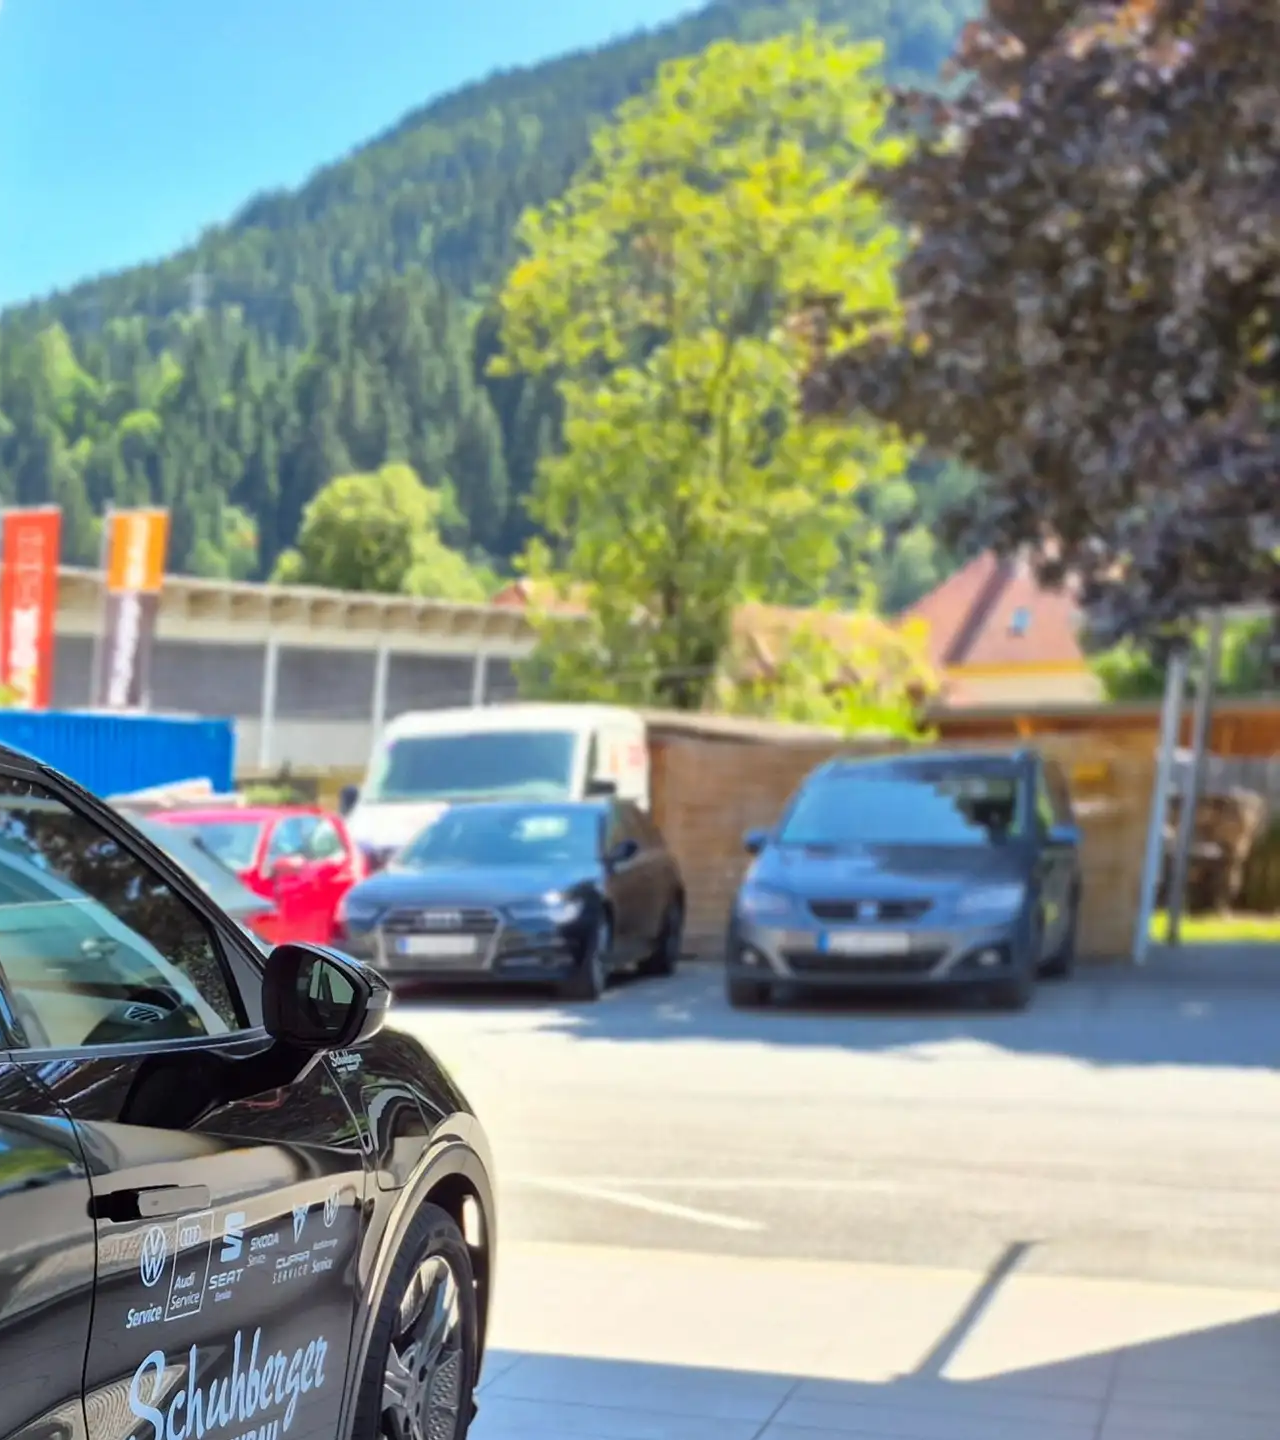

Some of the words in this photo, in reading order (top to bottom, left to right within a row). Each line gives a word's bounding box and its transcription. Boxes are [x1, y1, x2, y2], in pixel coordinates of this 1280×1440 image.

[174, 1271, 196, 1290] Audi
[208, 1269, 244, 1290] SEAT
[170, 1291, 200, 1310] Service
[126, 1303, 162, 1329] Service
